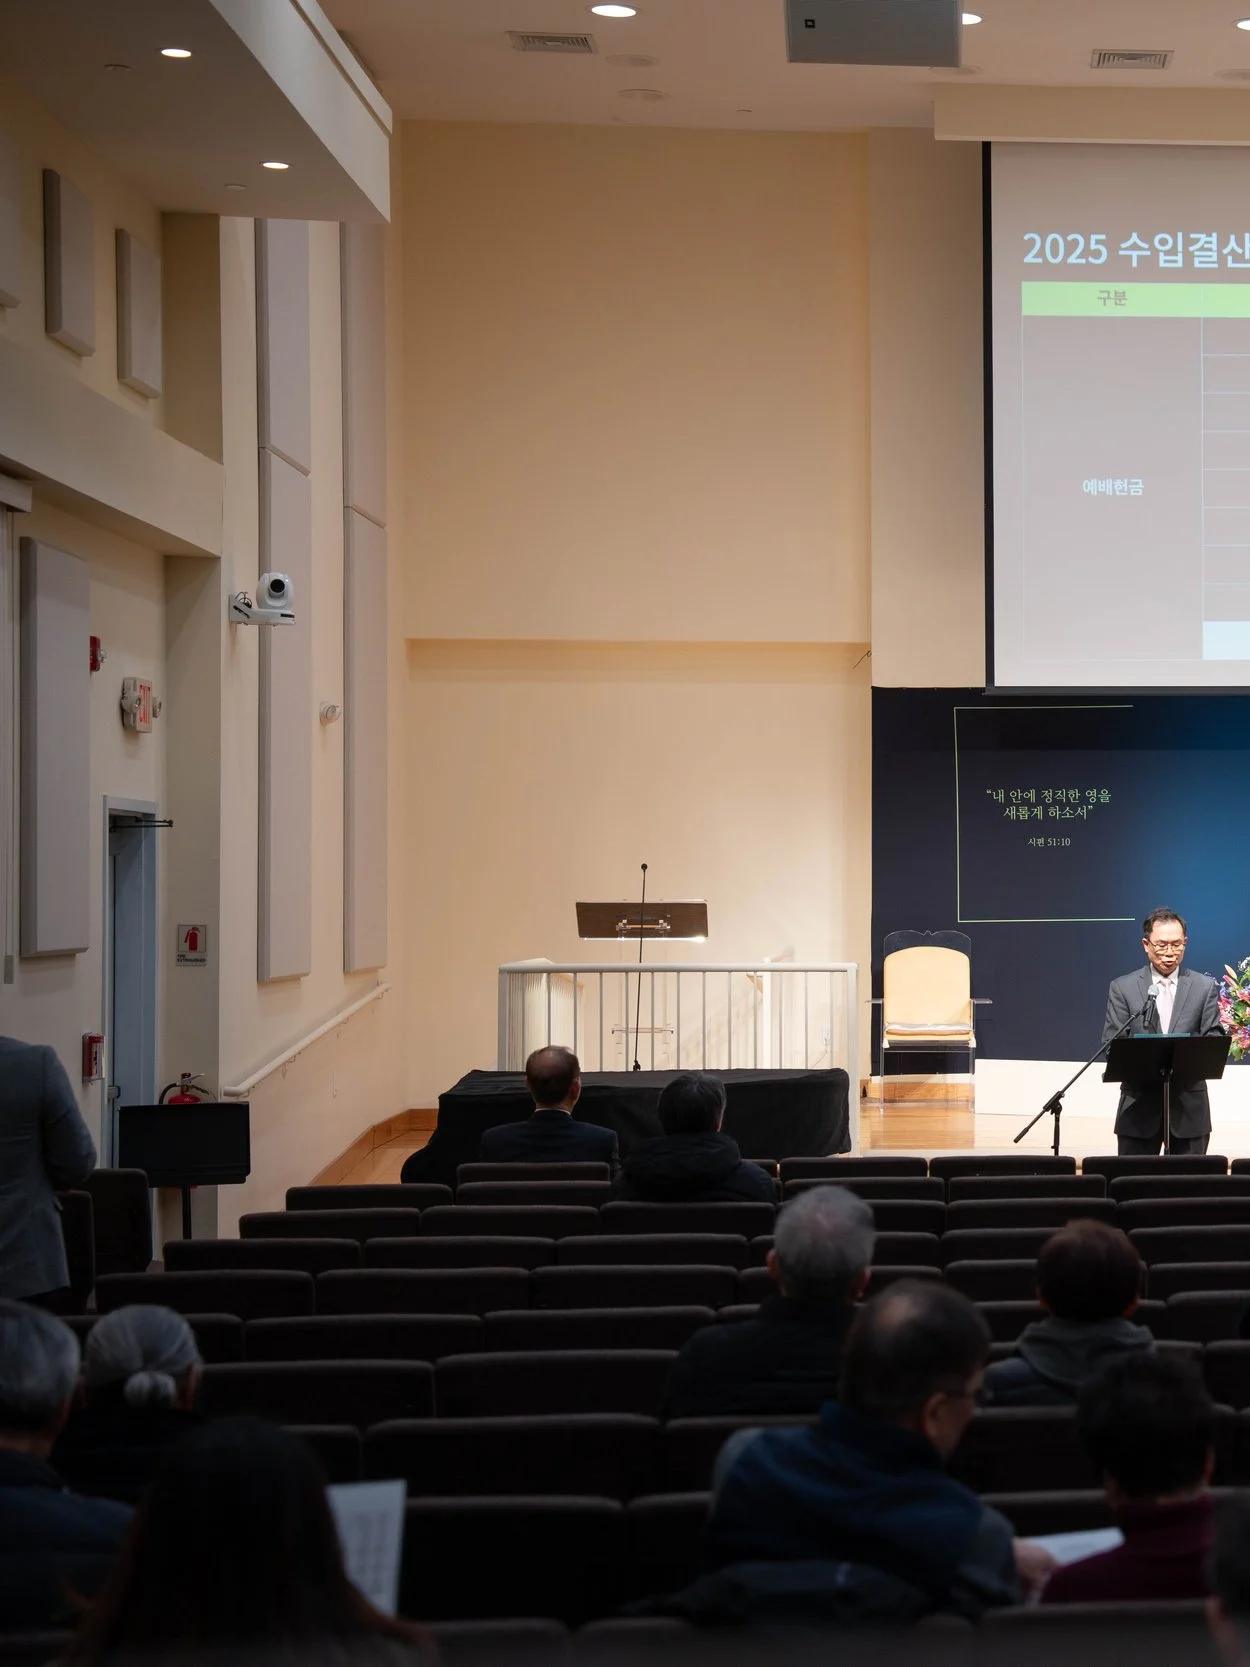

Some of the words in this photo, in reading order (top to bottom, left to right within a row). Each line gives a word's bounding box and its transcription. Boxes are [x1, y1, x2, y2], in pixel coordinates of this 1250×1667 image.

[1023, 233, 1107, 264] 2025
[1097, 290, 1127, 307] 구분
[1083, 478, 1144, 496] 예배헌금
[1009, 789, 1035, 803] 안에
[1041, 789, 1081, 803] 정직한
[1085, 789, 1111, 803] 영을
[1003, 806, 1043, 820] 새롭게
[1048, 805, 1093, 820] 하소서”
[1028, 837, 1044, 847] 시편
[1047, 838, 1071, 846] 51:10
